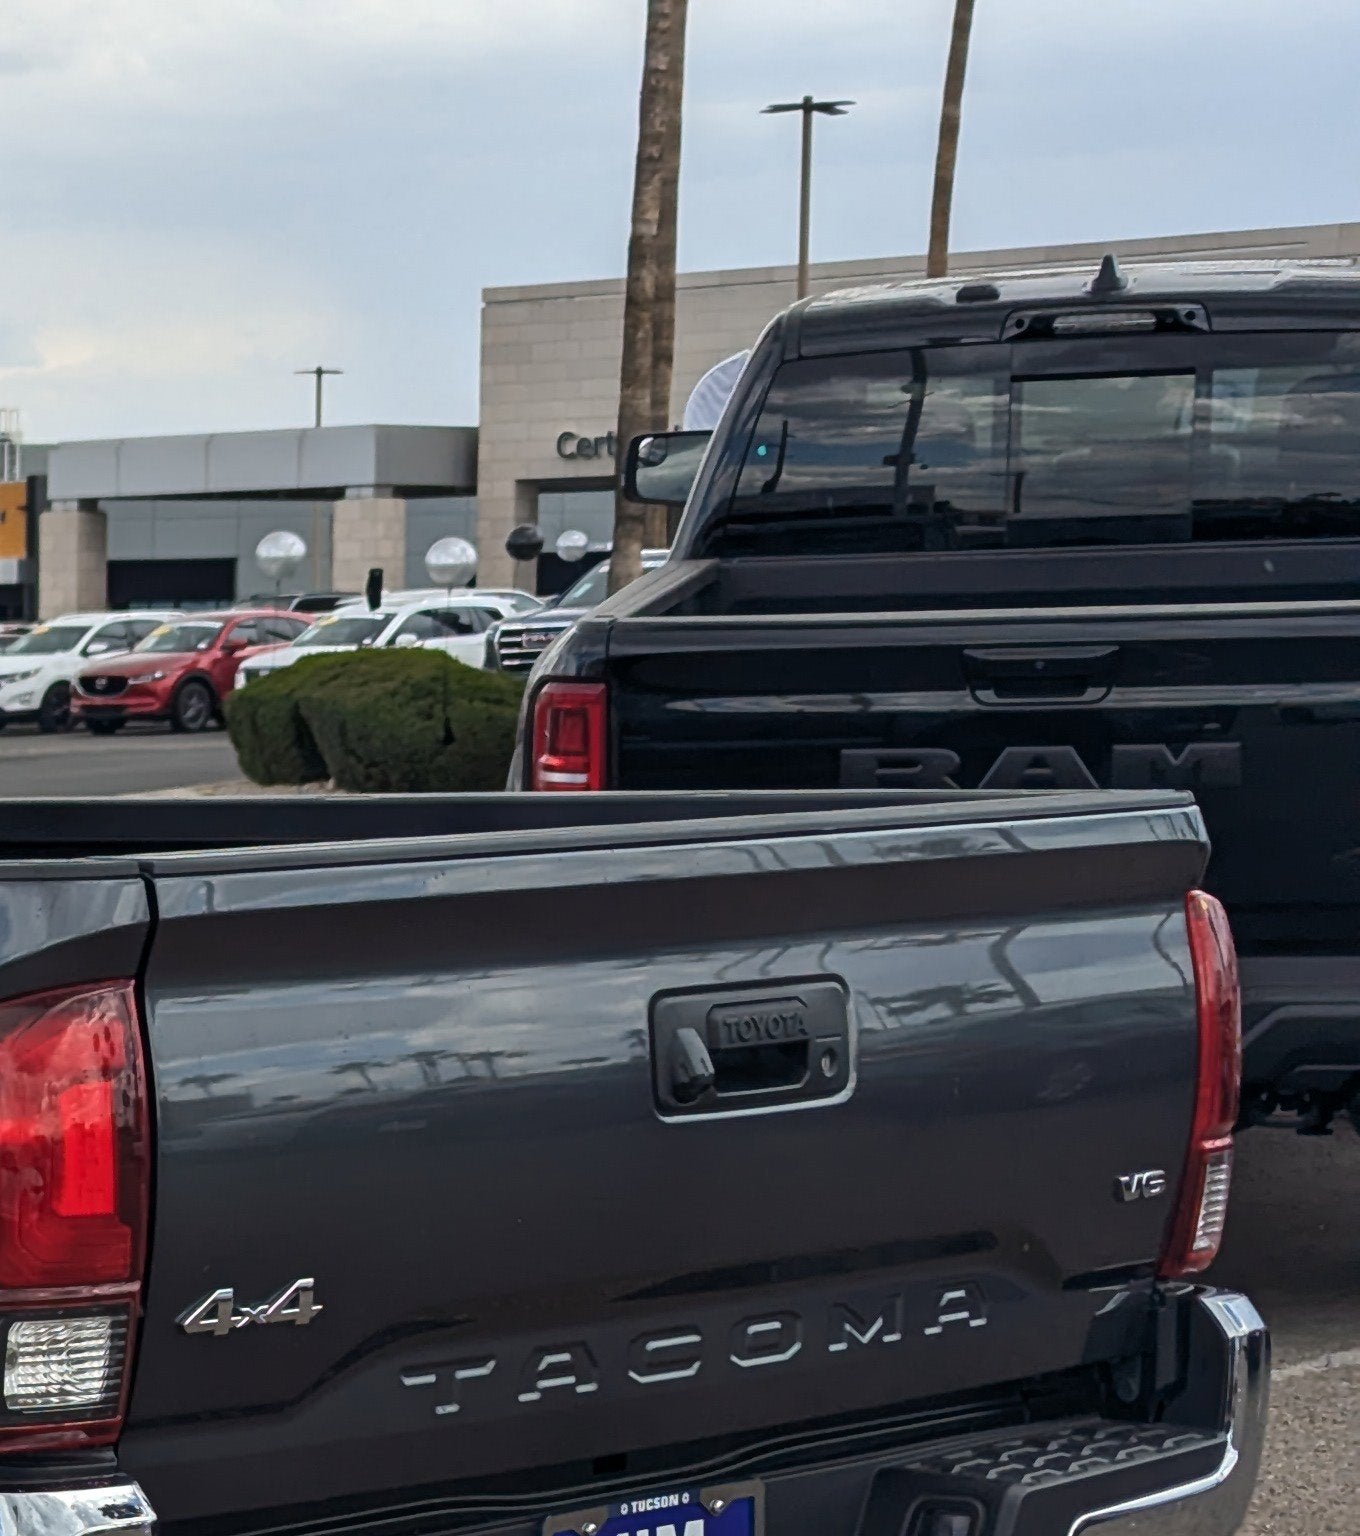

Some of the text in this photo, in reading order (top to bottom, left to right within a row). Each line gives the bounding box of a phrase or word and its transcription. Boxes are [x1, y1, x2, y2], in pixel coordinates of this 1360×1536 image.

[840, 742, 1242, 790] RAM
[724, 1012, 810, 1043] TOYOTA
[1118, 1169, 1166, 1201] V6
[398, 1279, 993, 1415] TACOMA
[631, 1493, 679, 1513] TUCSON
